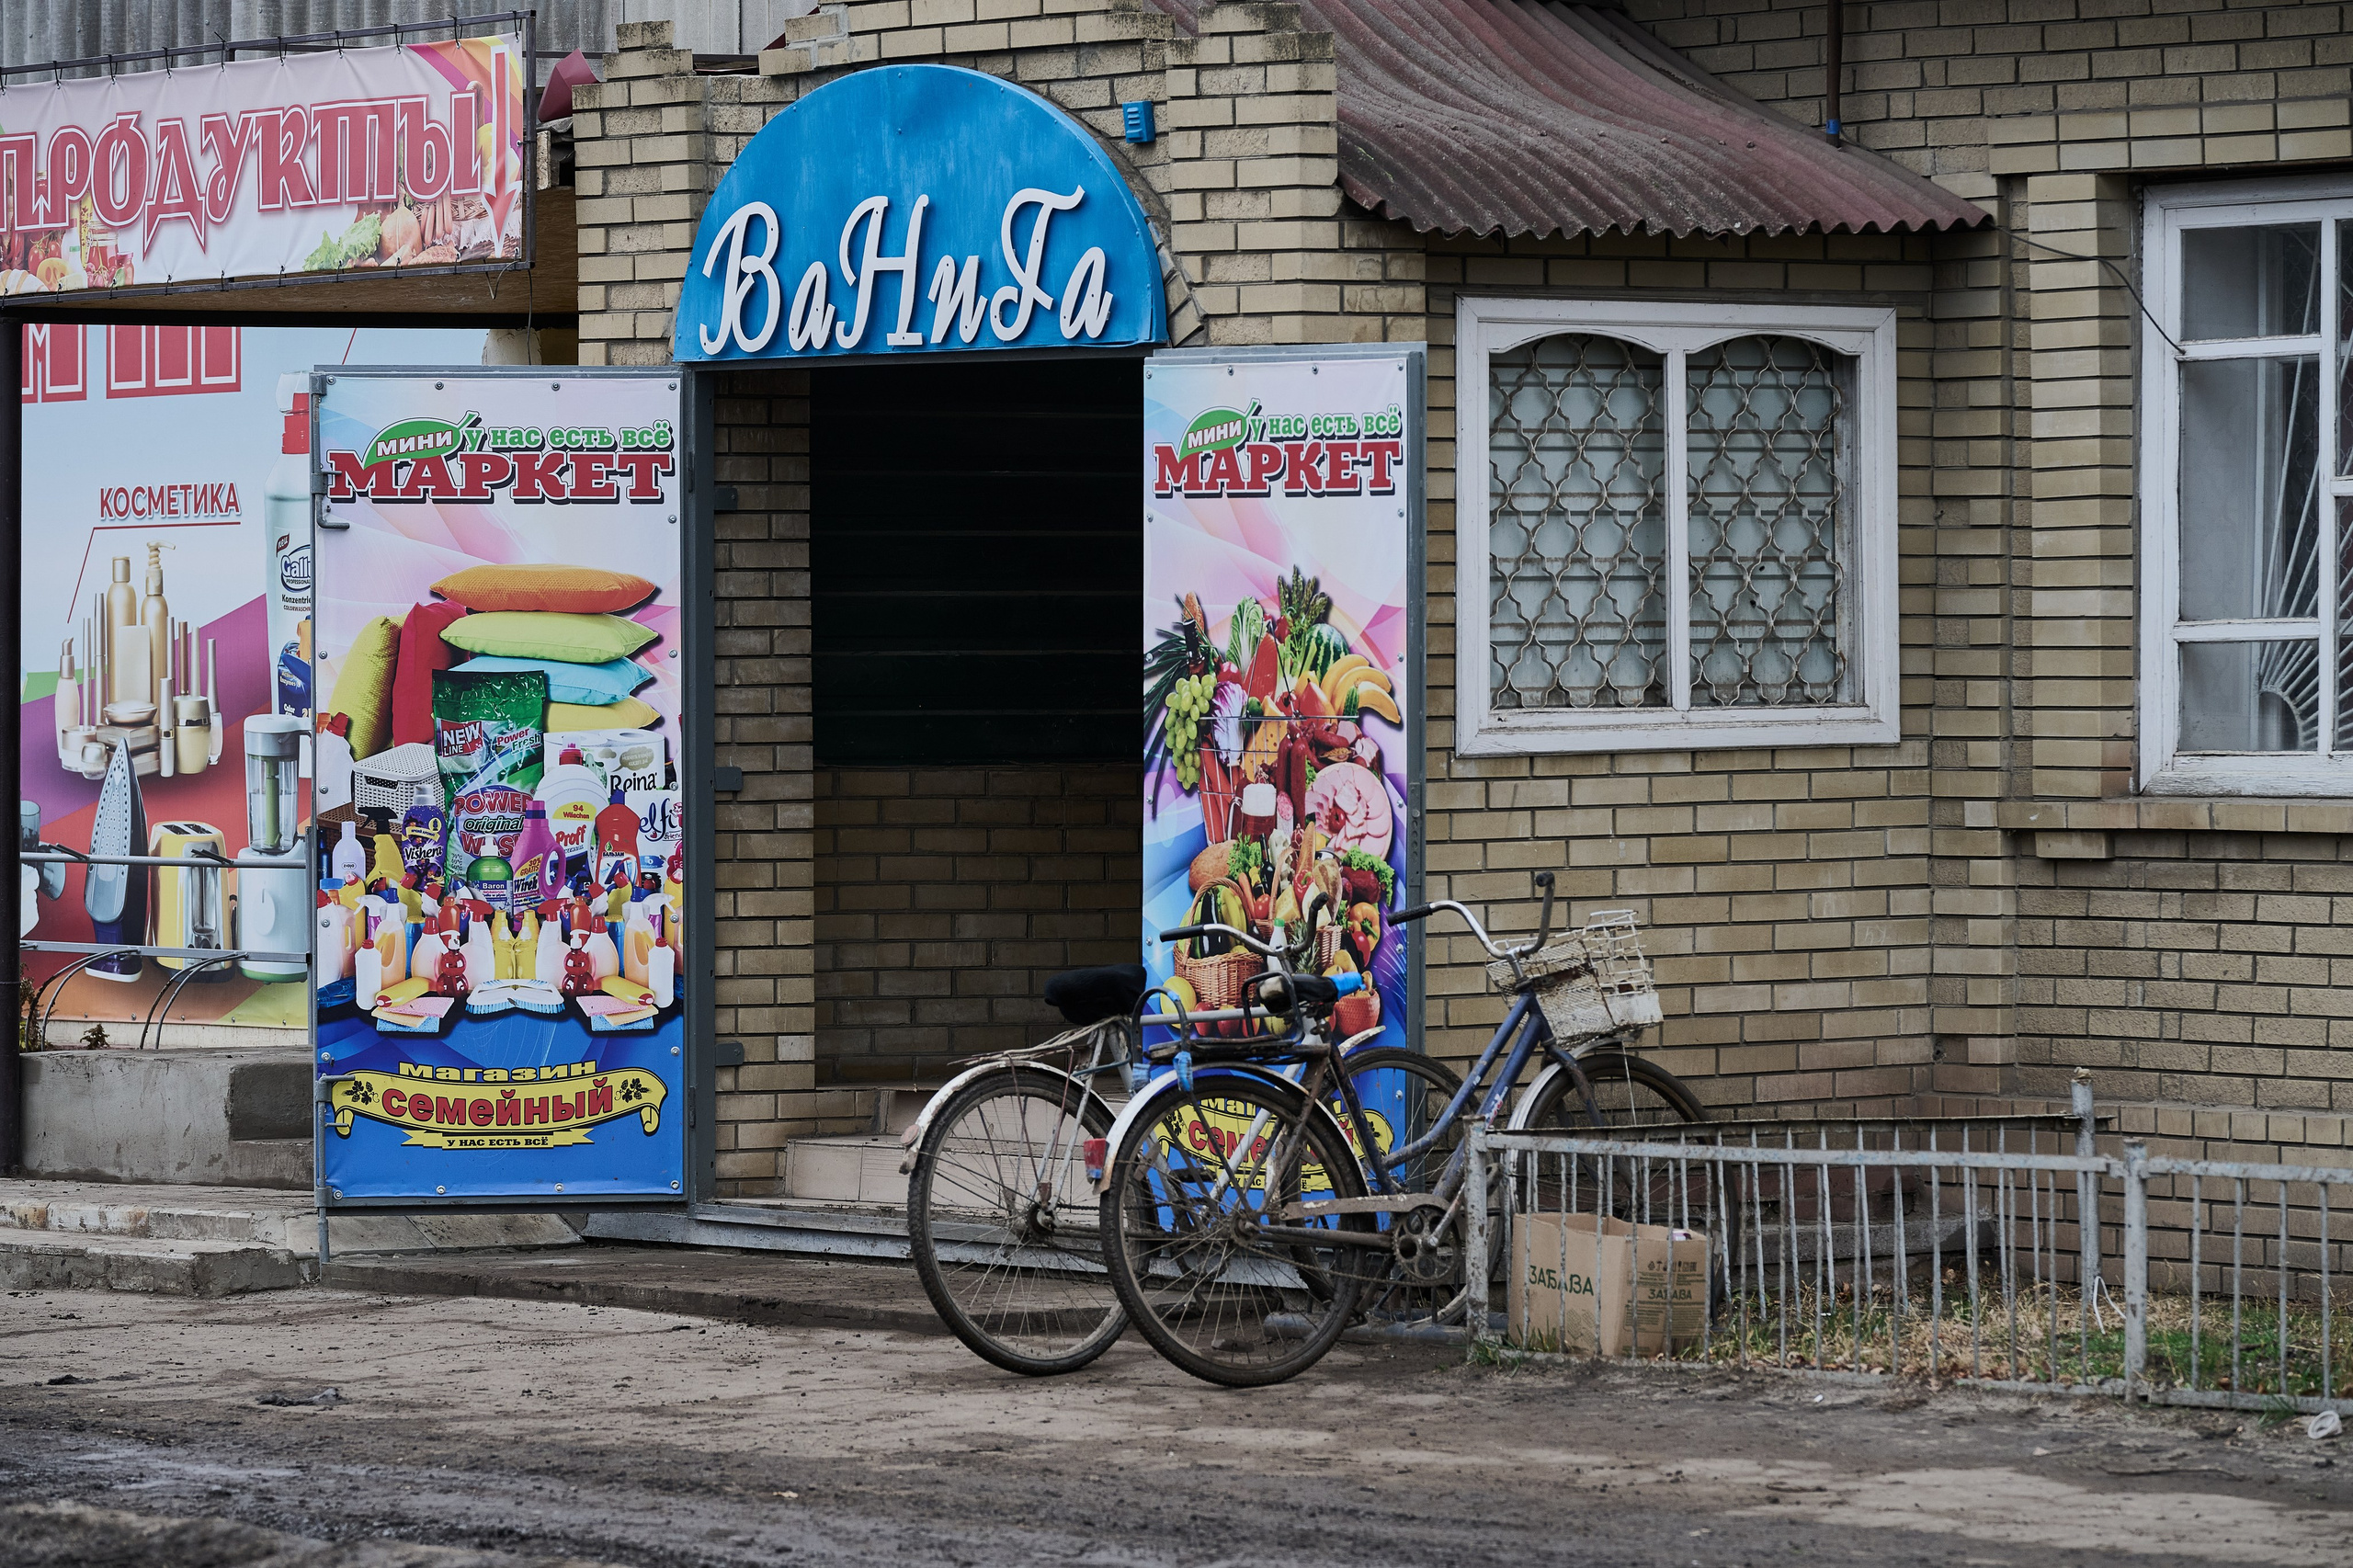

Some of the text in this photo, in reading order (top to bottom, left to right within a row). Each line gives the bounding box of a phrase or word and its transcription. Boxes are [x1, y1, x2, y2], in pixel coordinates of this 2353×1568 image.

[0, 91, 483, 262] ПРОДУКТЫ
[699, 185, 1114, 356] ВаНиТа
[1268, 416, 1305, 436] нас
[1312, 415, 1358, 436] есть
[1364, 405, 1400, 434] всё
[490, 427, 541, 447] нас
[549, 427, 613, 447] есть
[620, 422, 671, 447] всё
[327, 450, 672, 500] МАРКЕТ
[1154, 440, 1402, 494] МАРКЕТ
[99, 482, 241, 519] КОСМЕТИКА
[443, 722, 481, 746] NEW
[496, 728, 530, 745] Power
[512, 733, 541, 751] Fresh
[443, 744, 464, 756] LINE
[463, 815, 525, 834] original
[555, 824, 586, 846] Proff
[404, 846, 442, 860] Vishera
[398, 1060, 597, 1083] магазин
[447, 1136, 549, 1147] У НАС ЕСТЬ ВСЁ
